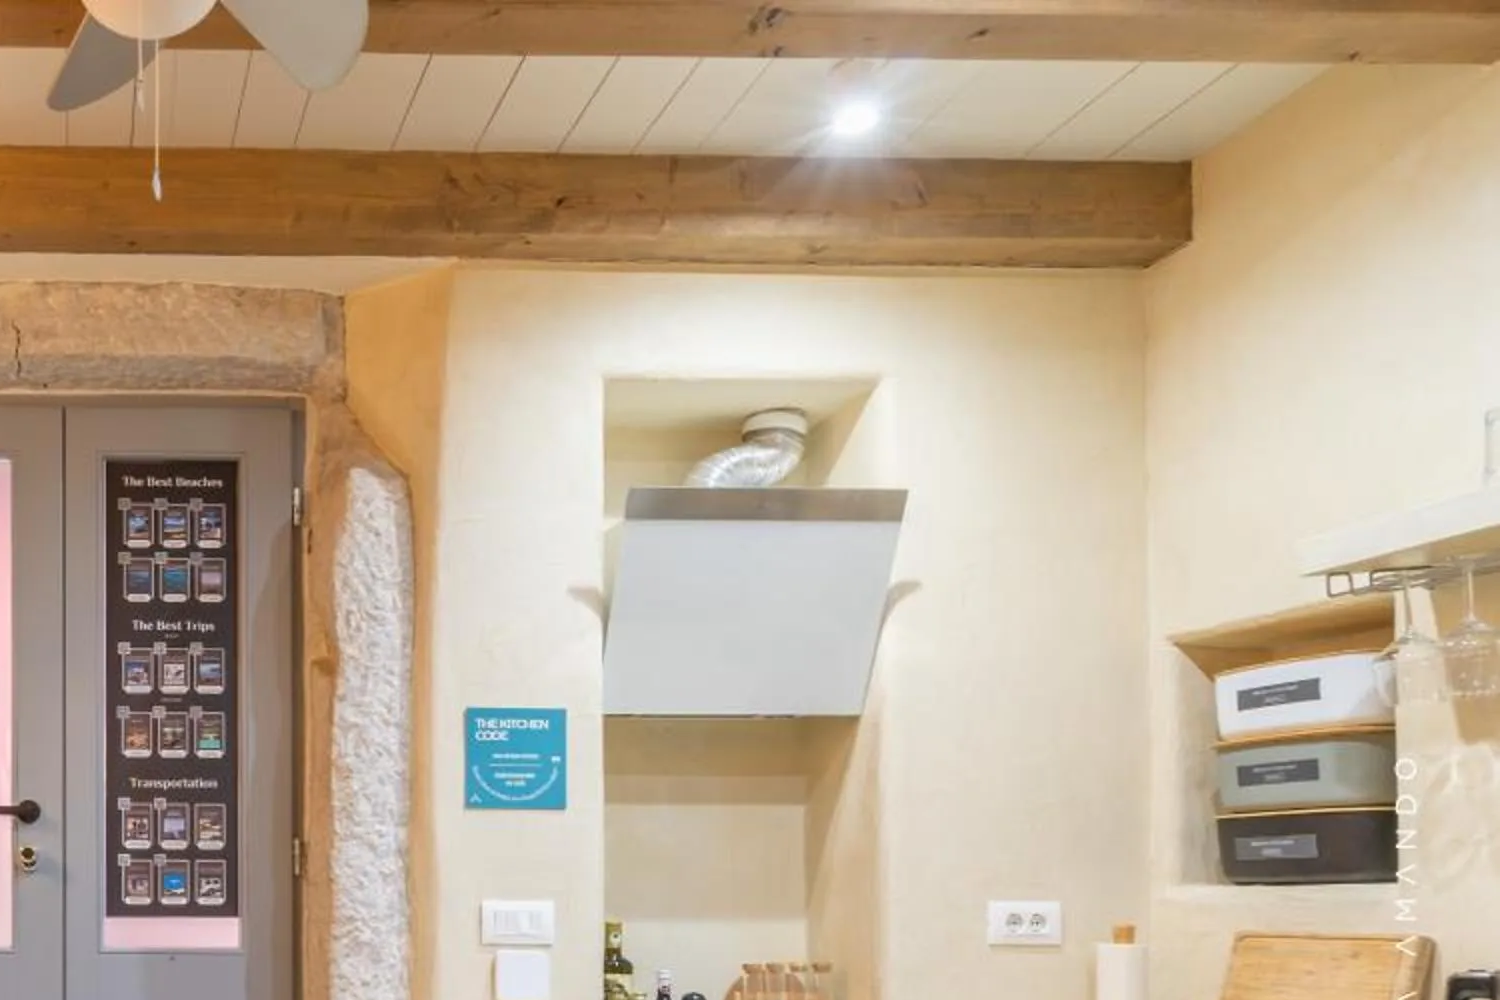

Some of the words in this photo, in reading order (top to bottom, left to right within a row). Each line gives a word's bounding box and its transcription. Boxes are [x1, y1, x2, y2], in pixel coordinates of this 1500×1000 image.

[122, 476, 144, 488] The
[147, 476, 173, 488] Best
[175, 476, 223, 488] Beaches
[132, 620, 154, 632] The
[156, 620, 182, 632] Best
[184, 620, 216, 634] Trips
[475, 718, 499, 729] THE
[500, 719, 550, 730] KITCHEN
[130, 777, 219, 791] Transportation
